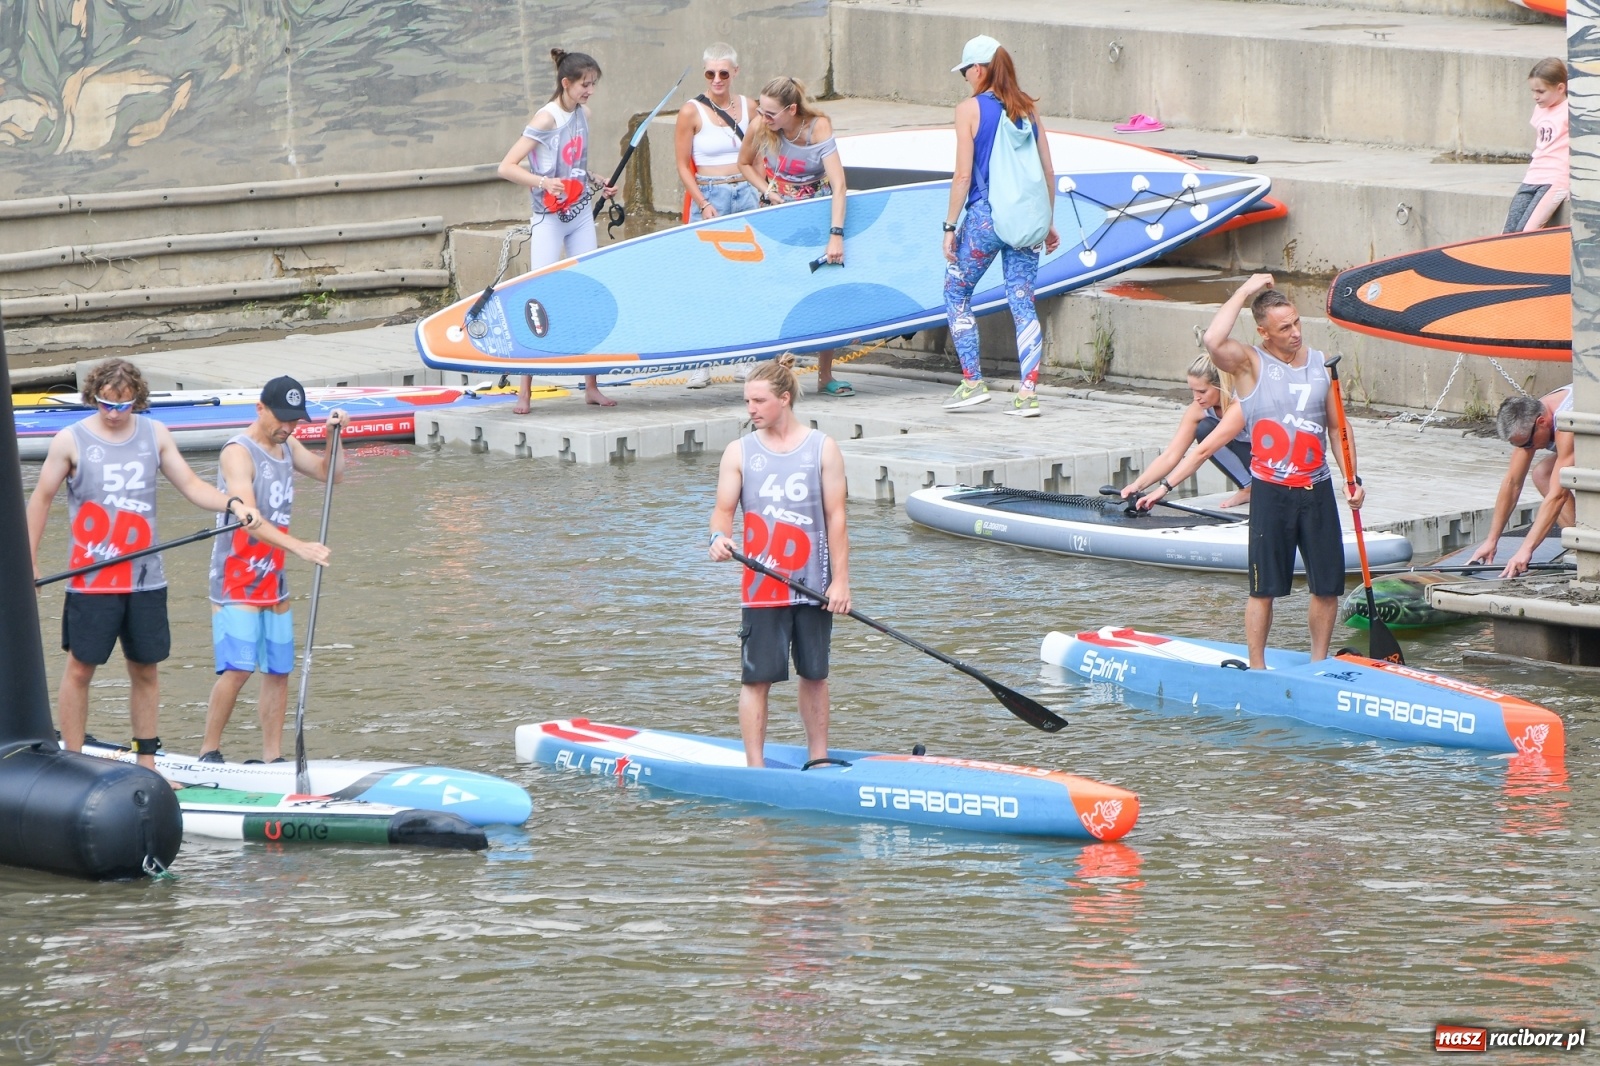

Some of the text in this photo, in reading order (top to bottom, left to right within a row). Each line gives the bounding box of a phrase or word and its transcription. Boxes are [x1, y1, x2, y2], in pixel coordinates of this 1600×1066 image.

[1288, 383, 1312, 412] 7
[1282, 413, 1324, 434] NSP
[102, 461, 145, 492] 52
[759, 472, 809, 502] 46
[103, 494, 152, 513] NSP
[762, 504, 814, 525] NSP
[1080, 649, 1129, 682] Sprint
[170, 762, 202, 772] SIC
